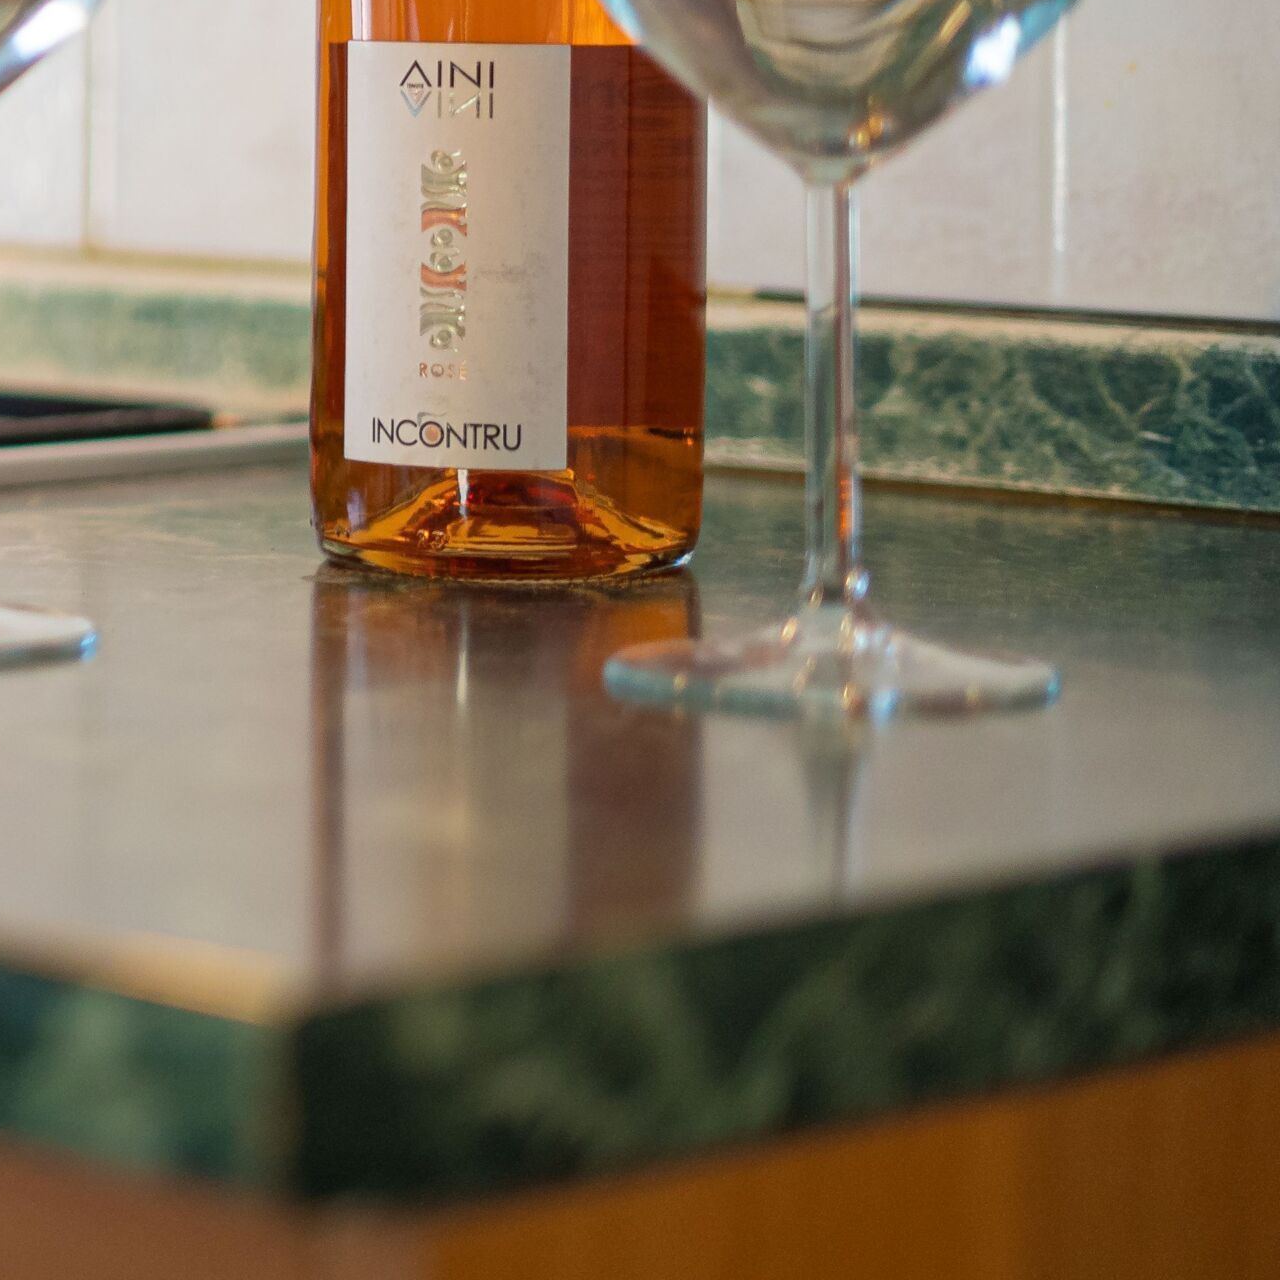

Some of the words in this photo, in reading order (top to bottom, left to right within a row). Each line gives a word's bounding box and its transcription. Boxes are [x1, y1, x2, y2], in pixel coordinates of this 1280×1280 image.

[399, 59, 495, 89] AINI
[417, 359, 470, 381] ROSÉ
[371, 416, 522, 452] INCONTRU
